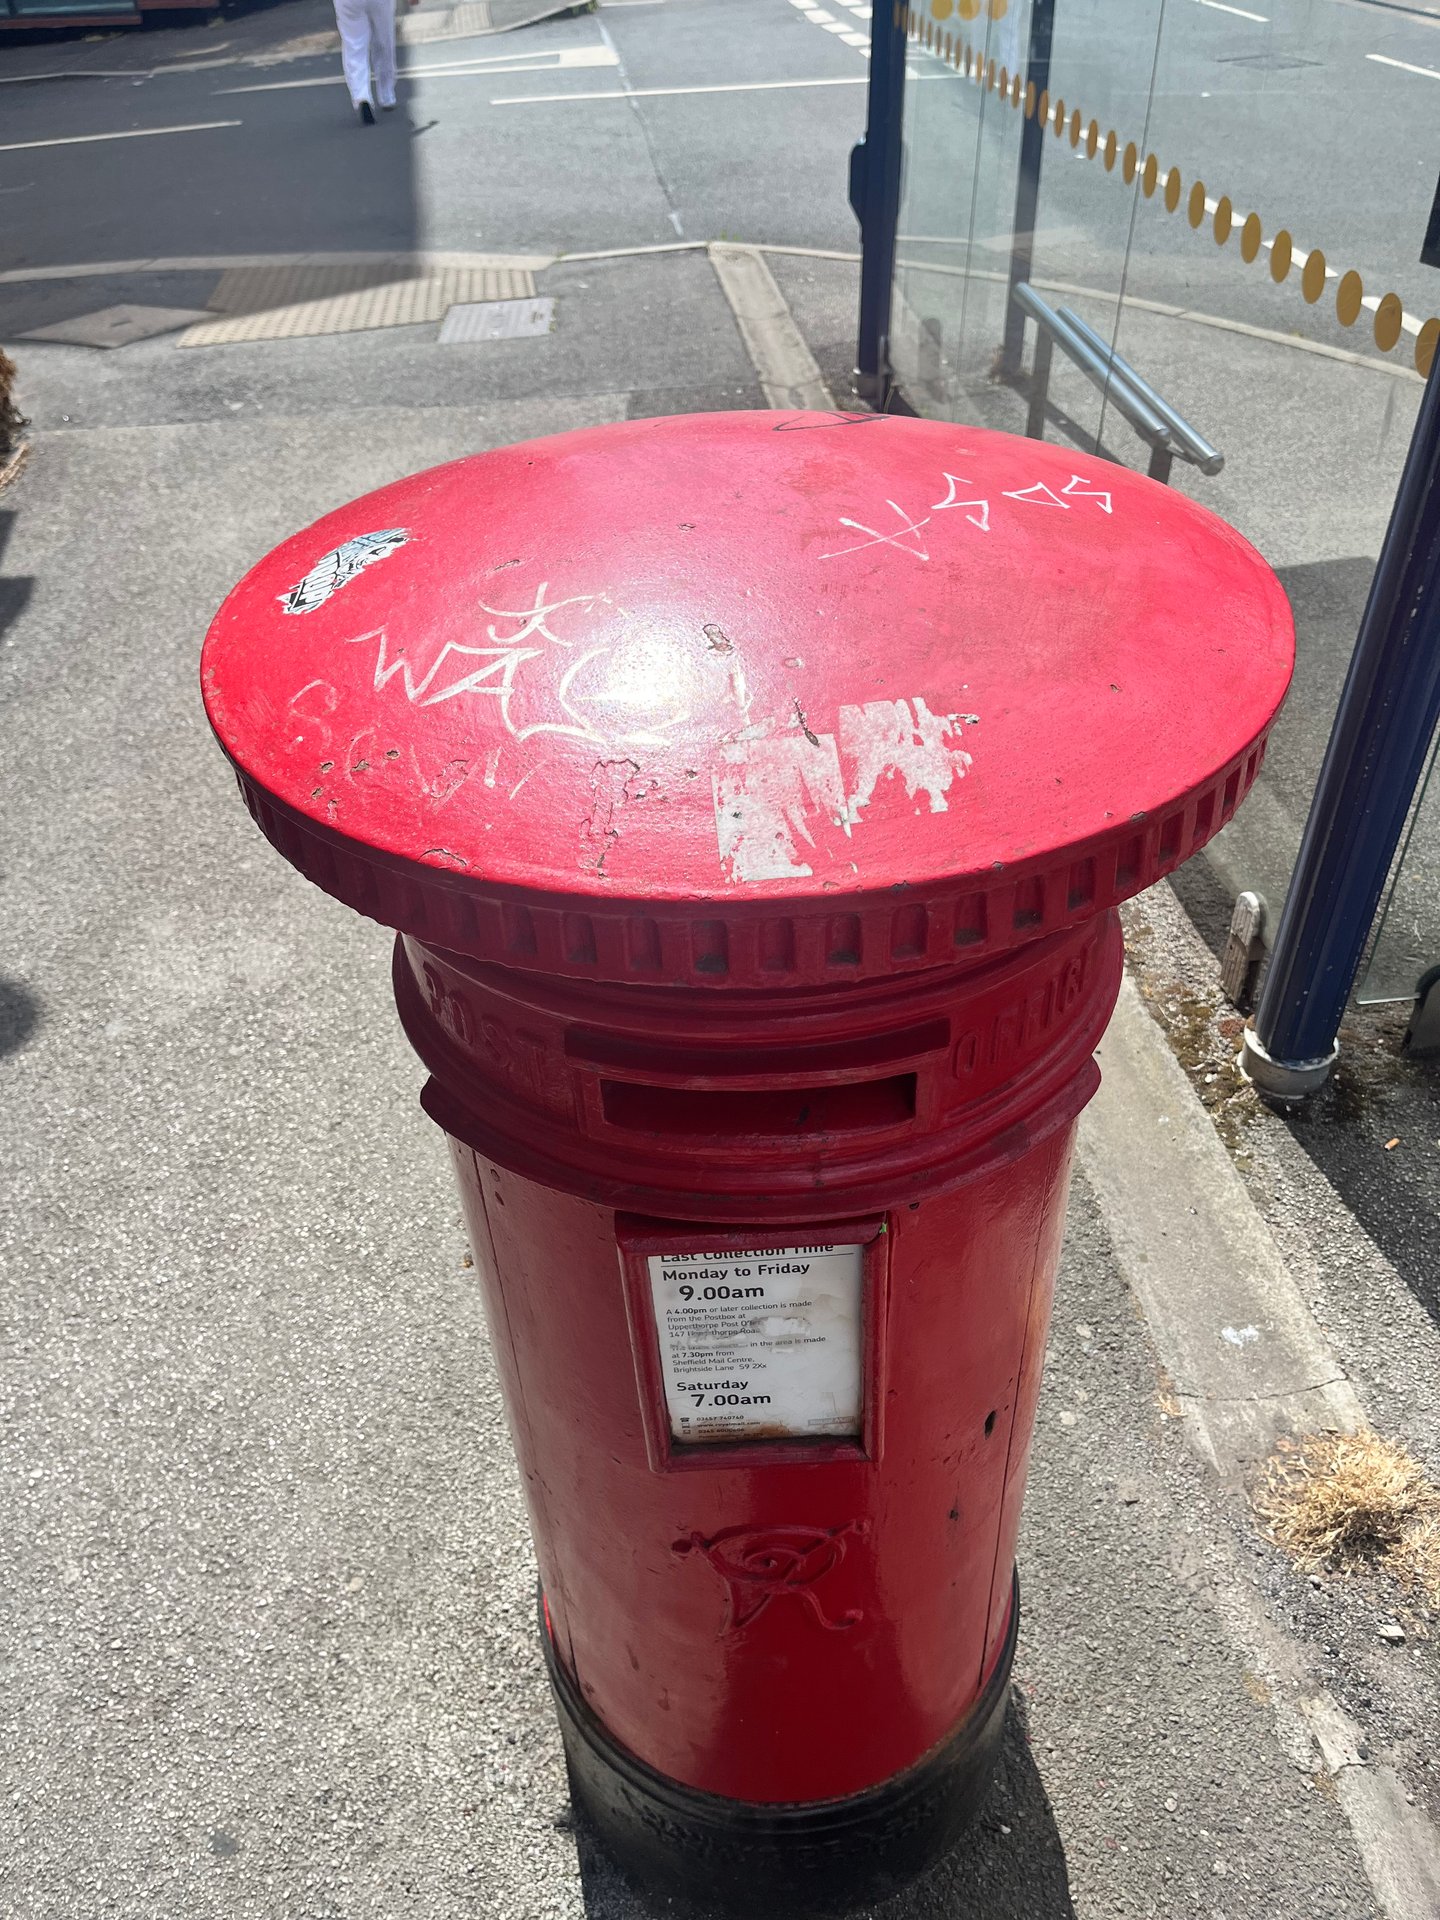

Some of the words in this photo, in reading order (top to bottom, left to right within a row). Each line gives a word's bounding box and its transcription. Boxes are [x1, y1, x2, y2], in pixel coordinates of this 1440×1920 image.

[662, 1268, 728, 1281] Monday
[734, 1267, 751, 1277] to
[758, 1263, 810, 1275] Friday
[679, 1285, 764, 1301] 9.00am
[674, 1307, 707, 1315] 4.00pm
[741, 1303, 778, 1311] collection
[789, 1300, 812, 1308] made
[704, 1313, 736, 1321] Postbox
[668, 1322, 719, 1331] Upperthorpe
[721, 1320, 739, 1328] Post
[775, 1338, 793, 1346] area
[803, 1335, 826, 1343] made
[682, 1351, 713, 1359] 7.30pm
[672, 1358, 706, 1366] Sheffield
[673, 1365, 713, 1374] Brightside
[677, 1380, 749, 1391] Saturday
[690, 1394, 771, 1407] 7.00am
